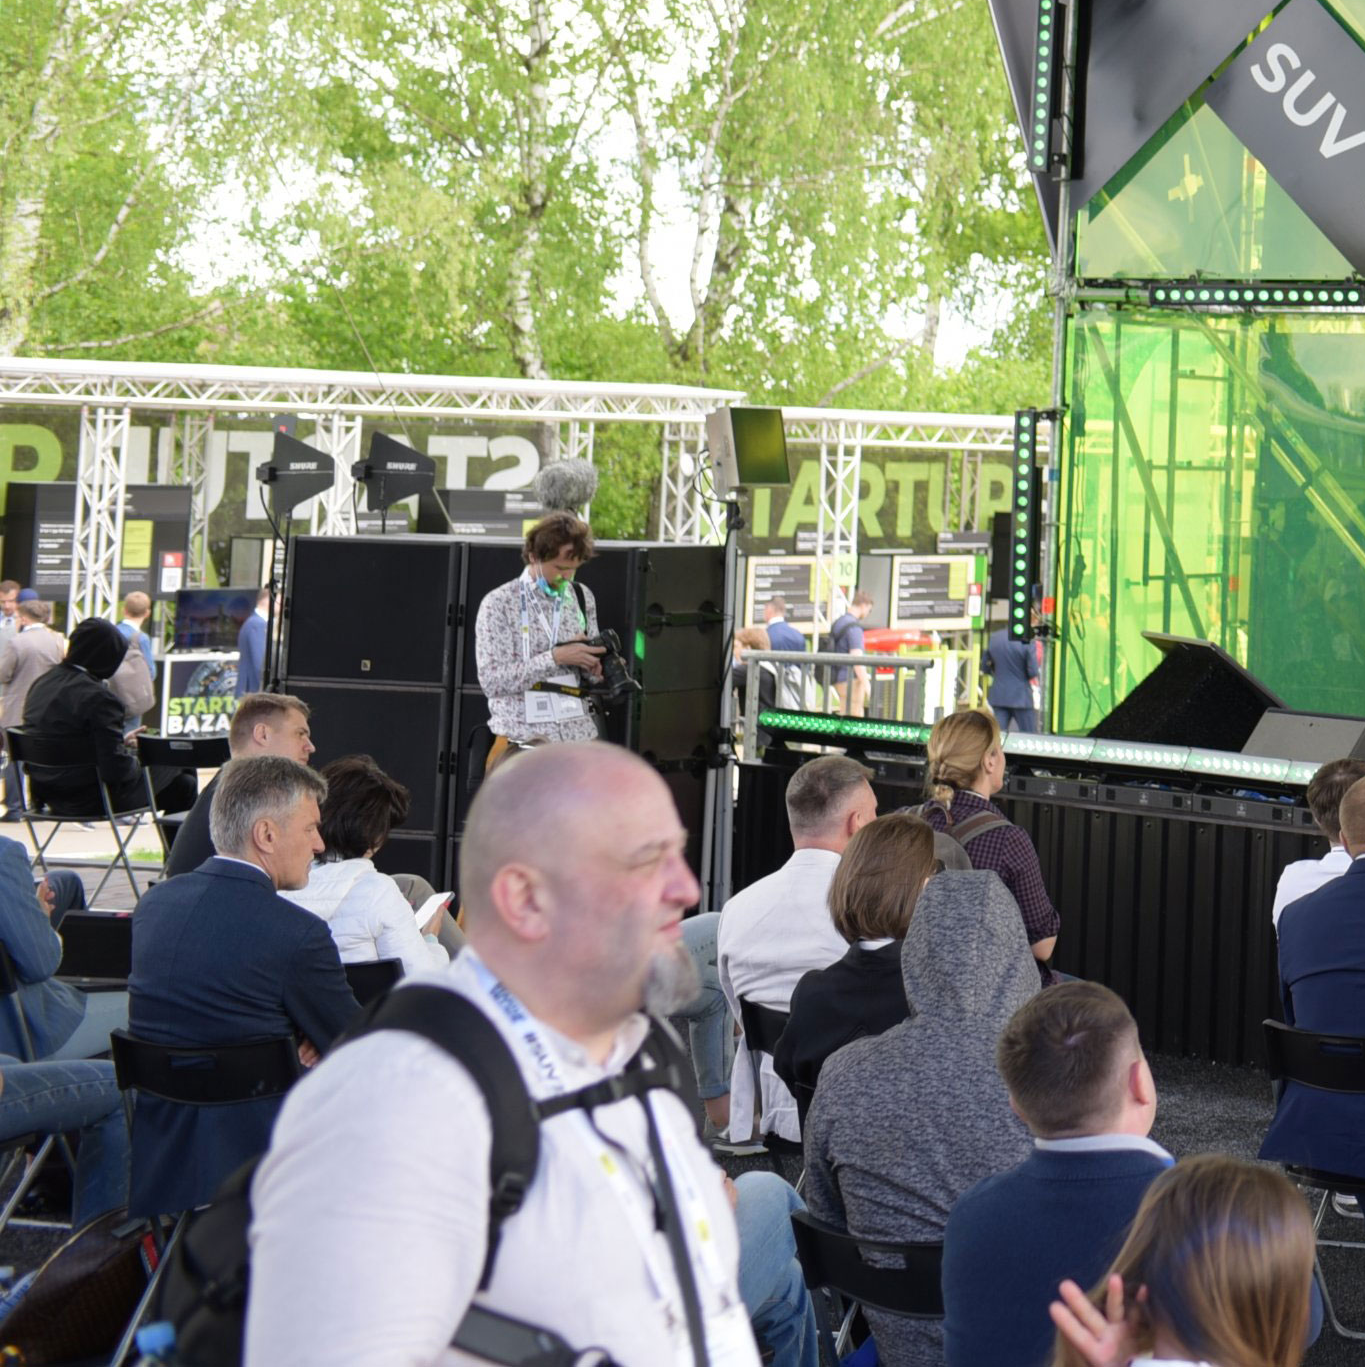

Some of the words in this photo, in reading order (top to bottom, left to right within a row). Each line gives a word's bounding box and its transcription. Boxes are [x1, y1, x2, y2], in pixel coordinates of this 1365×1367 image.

[289, 461, 318, 470] SHURE
[386, 461, 417, 471] SHURE
[838, 562, 852, 576] 10
[169, 697, 240, 715] START
